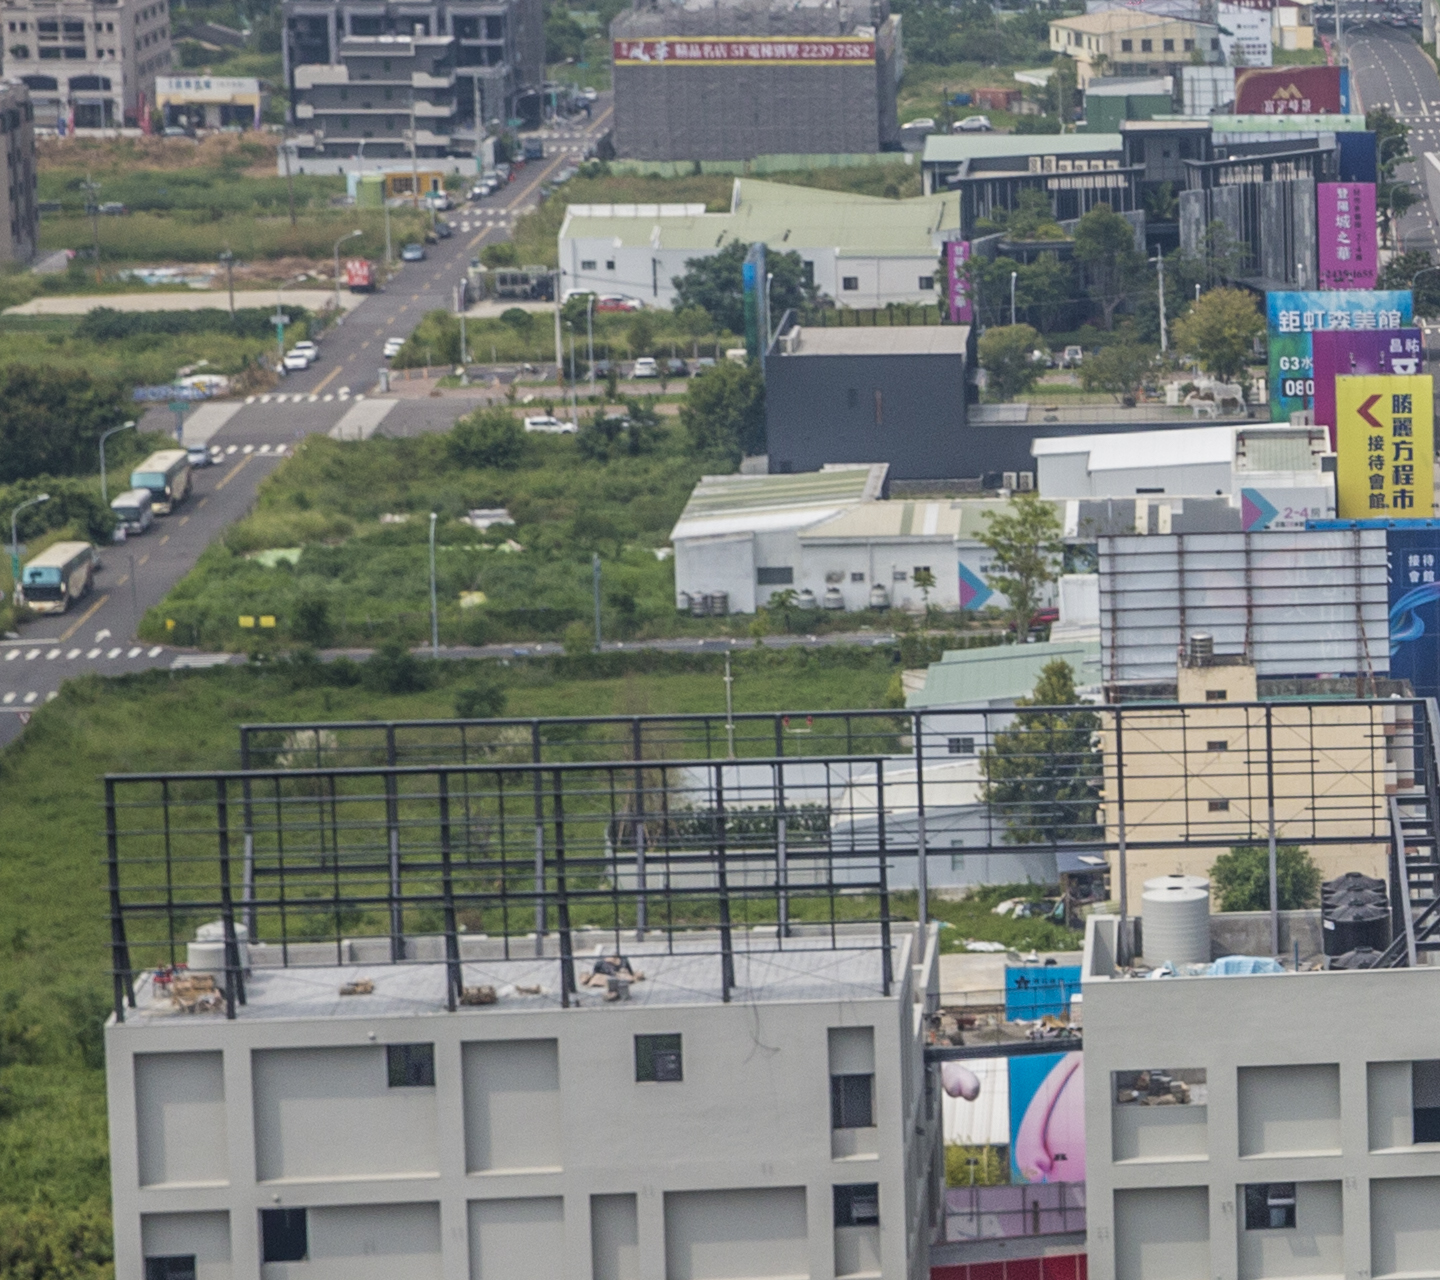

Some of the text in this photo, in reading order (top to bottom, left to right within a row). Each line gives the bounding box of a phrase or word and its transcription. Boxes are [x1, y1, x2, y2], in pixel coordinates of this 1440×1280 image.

[1392, 393, 1414, 510] 勝麗方程市
